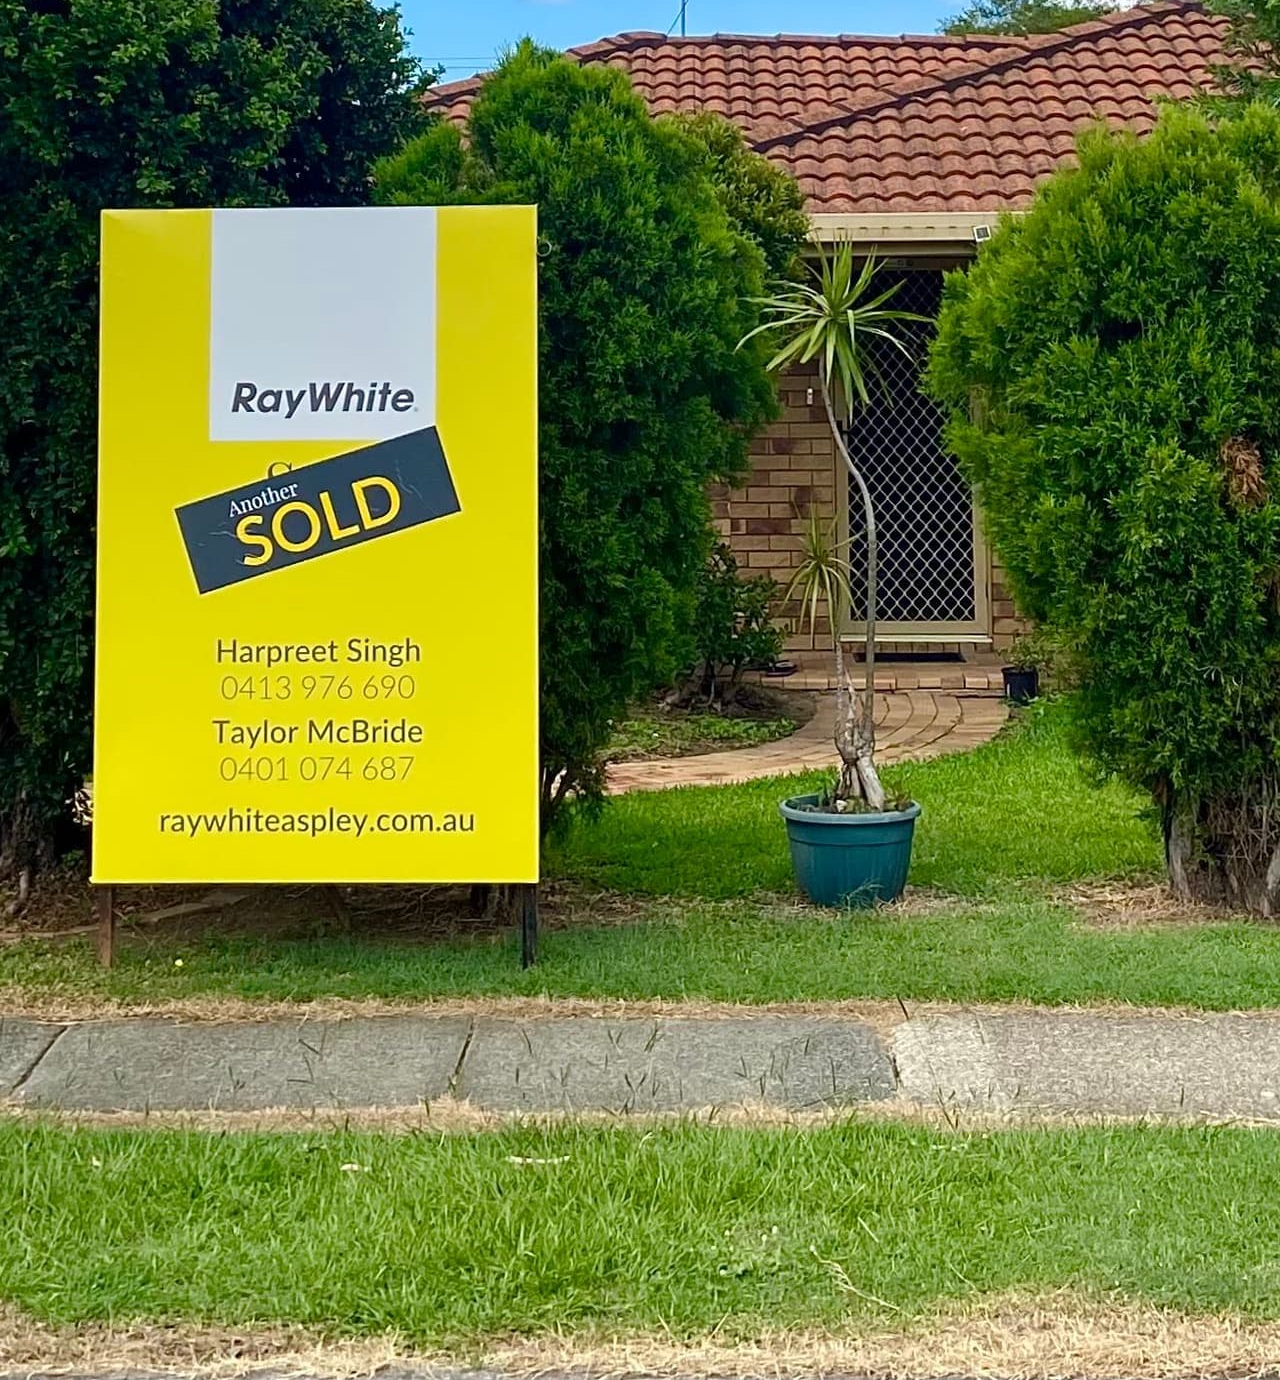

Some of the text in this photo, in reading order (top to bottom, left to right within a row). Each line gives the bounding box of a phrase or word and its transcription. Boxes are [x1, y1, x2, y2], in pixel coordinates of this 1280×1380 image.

[231, 382, 415, 419] RayWhite
[229, 482, 299, 518] Another
[235, 475, 402, 567] SOLD
[217, 637, 420, 667] Harpreet Singh
[220, 675, 414, 700] 0413 976 690
[212, 718, 423, 749] Taylor McBride
[219, 756, 414, 781] 0401 074 687
[160, 807, 474, 838] raywhiteaspley.com.au
